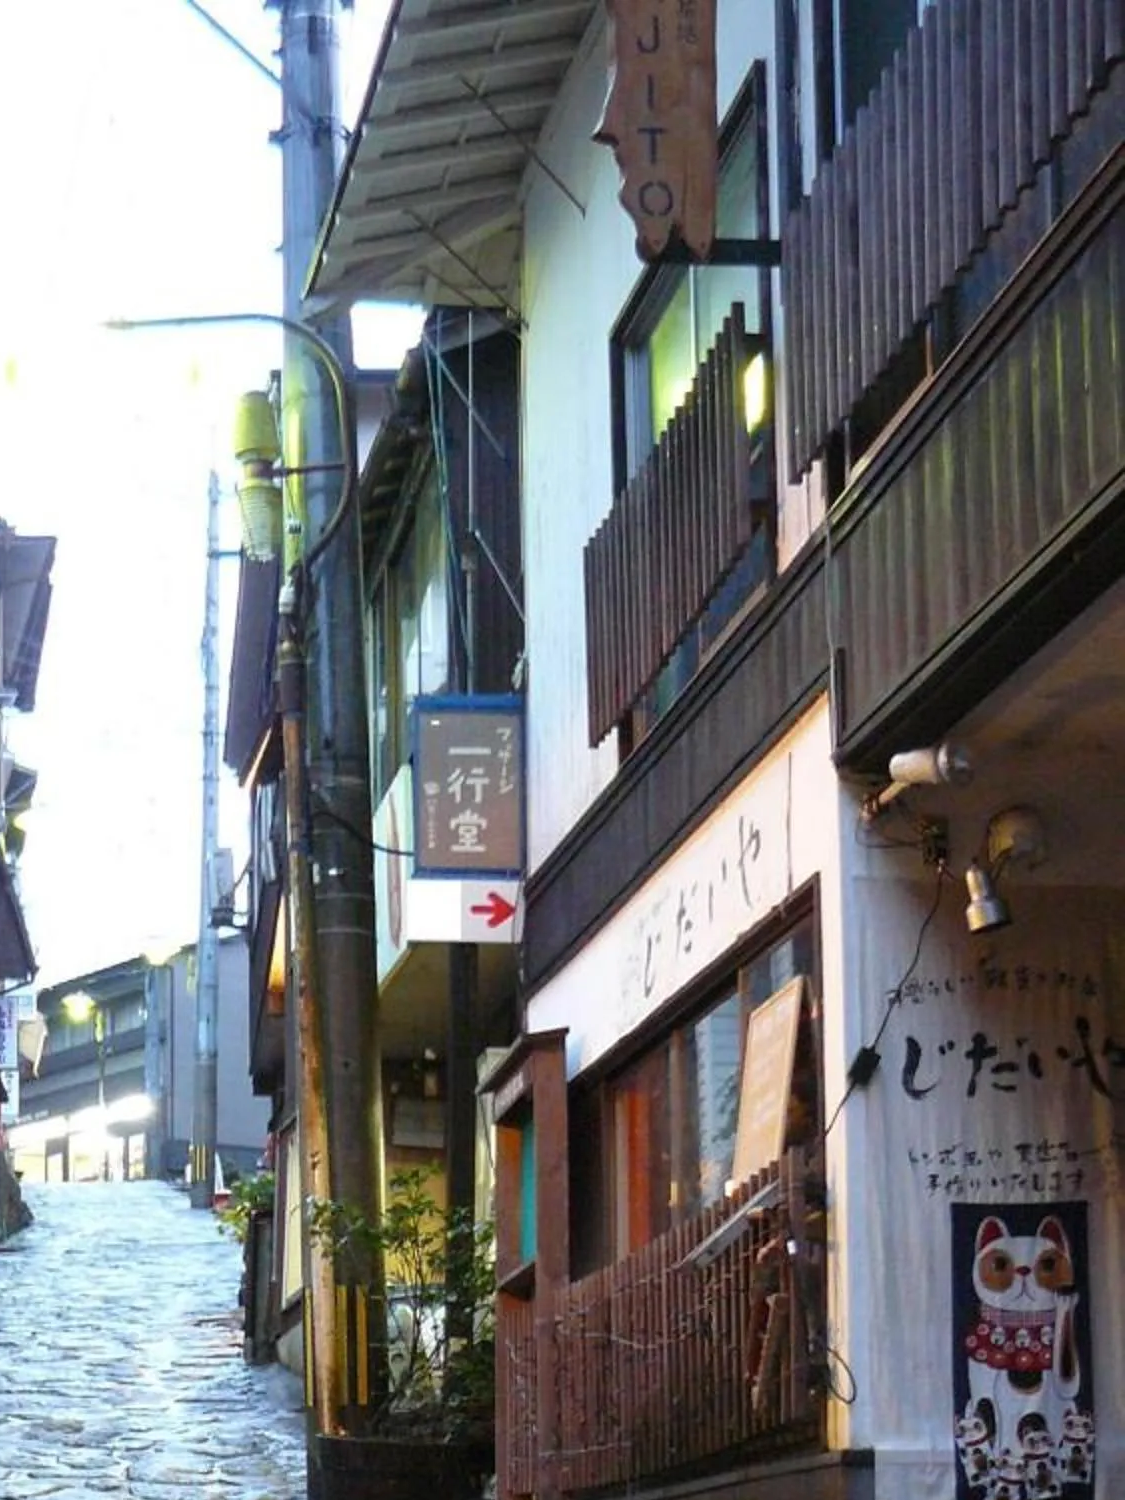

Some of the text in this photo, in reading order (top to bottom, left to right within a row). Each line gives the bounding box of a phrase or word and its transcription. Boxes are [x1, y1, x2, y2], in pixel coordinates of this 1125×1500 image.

[447, 746, 491, 853] 一行堂
[902, 1016, 1125, 1100] じだいや
